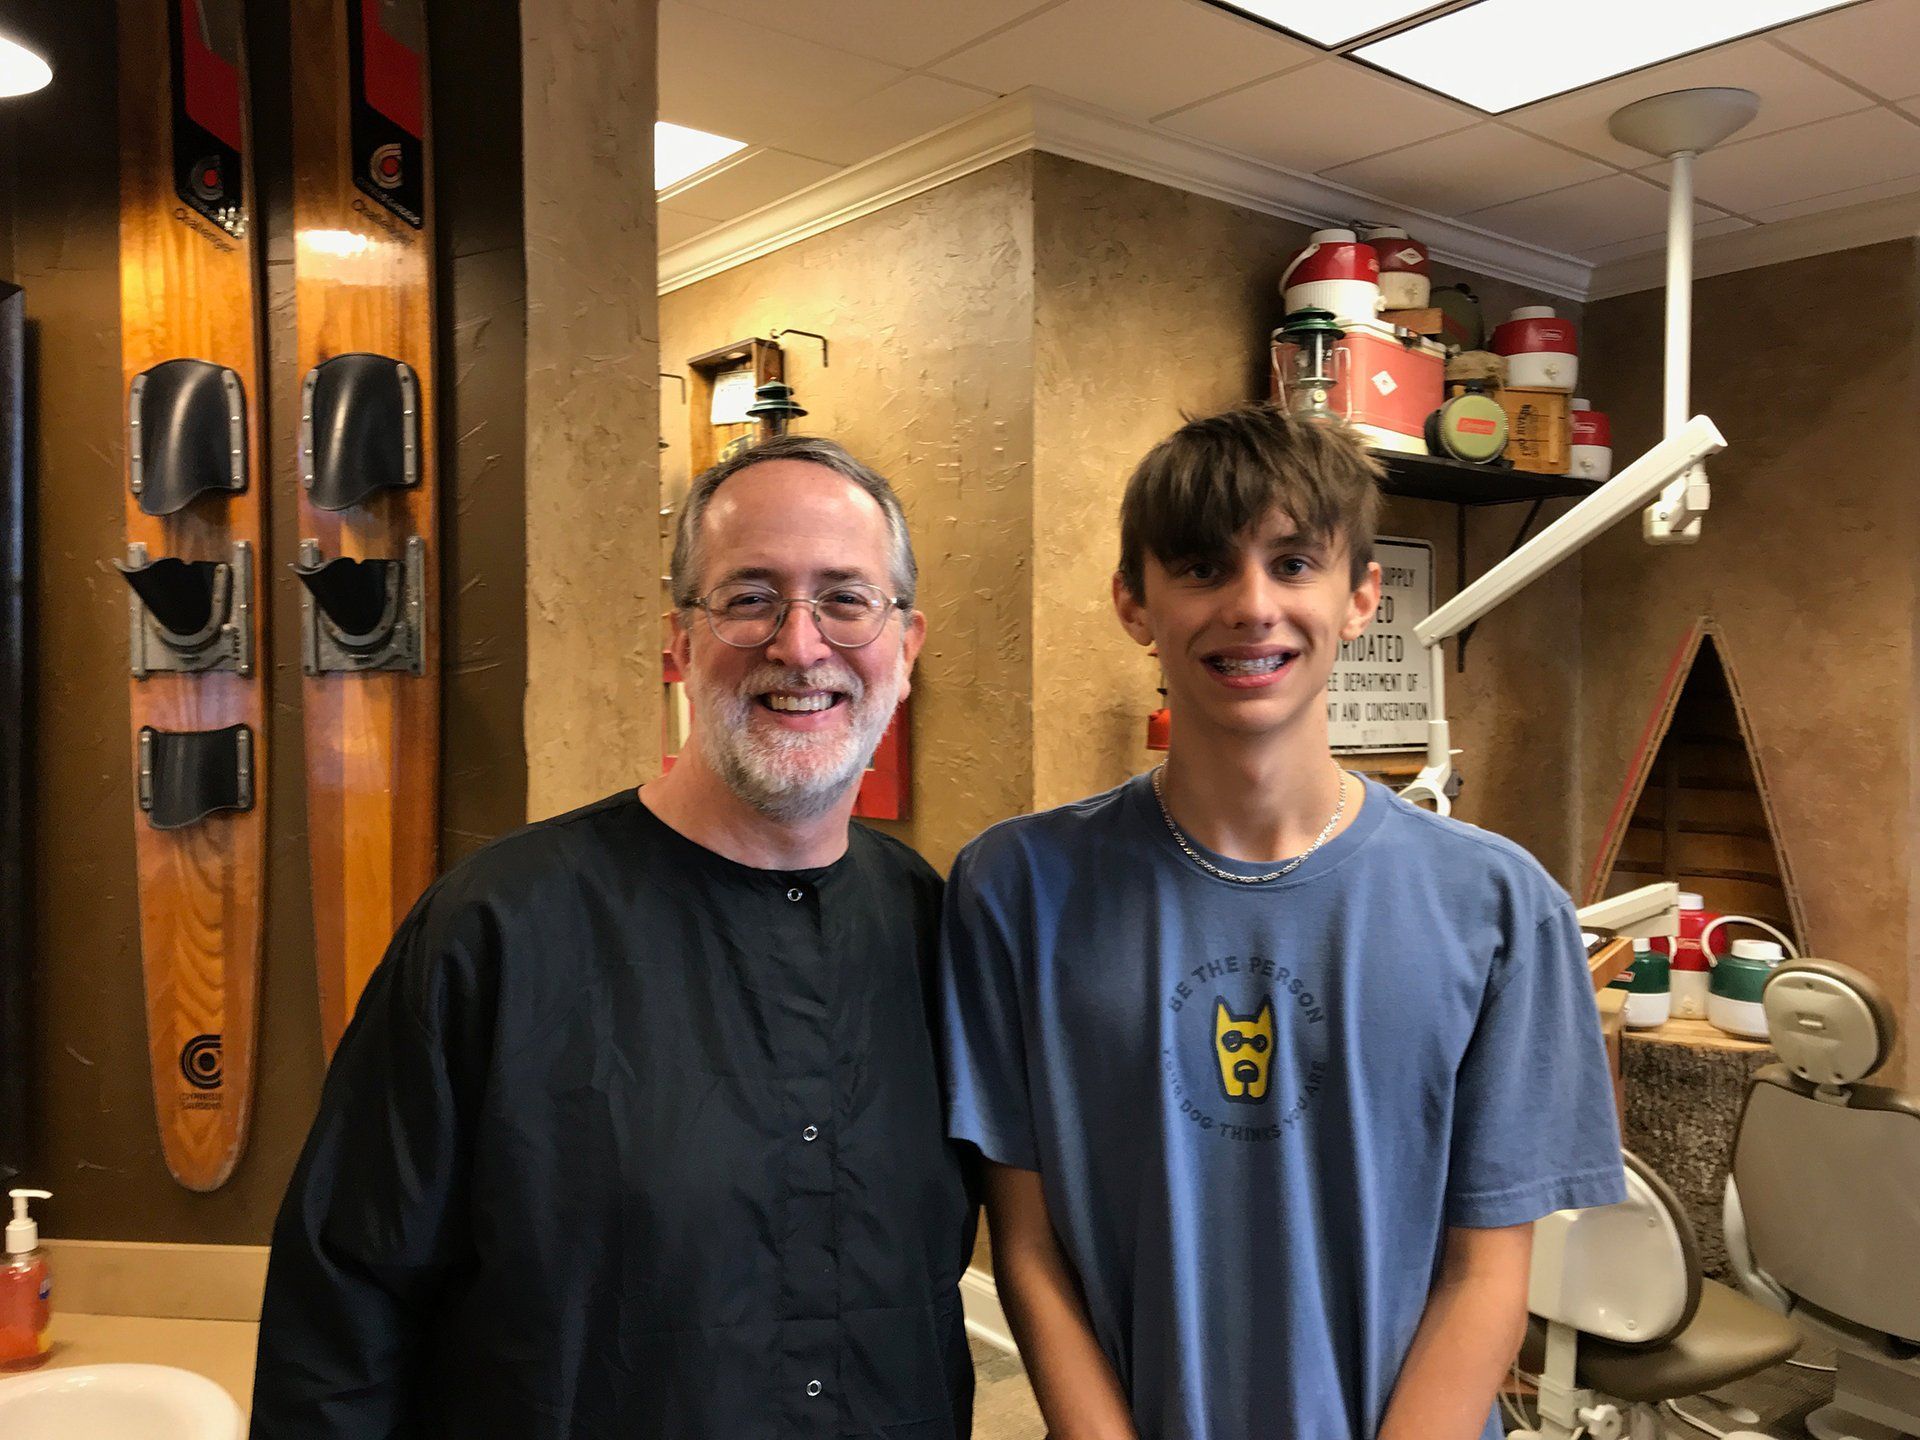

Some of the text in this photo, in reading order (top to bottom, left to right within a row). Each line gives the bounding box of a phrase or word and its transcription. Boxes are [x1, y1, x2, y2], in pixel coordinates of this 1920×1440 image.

[1344, 672, 1402, 692] DEPARTMENT
[1406, 672, 1418, 692] OF
[1342, 702, 1360, 722] AND
[1365, 702, 1429, 722] CONSERVATION
[1191, 955, 1240, 984] THE
[1249, 956, 1324, 1025] PERSON
[1181, 1099, 1214, 1130] DOG
